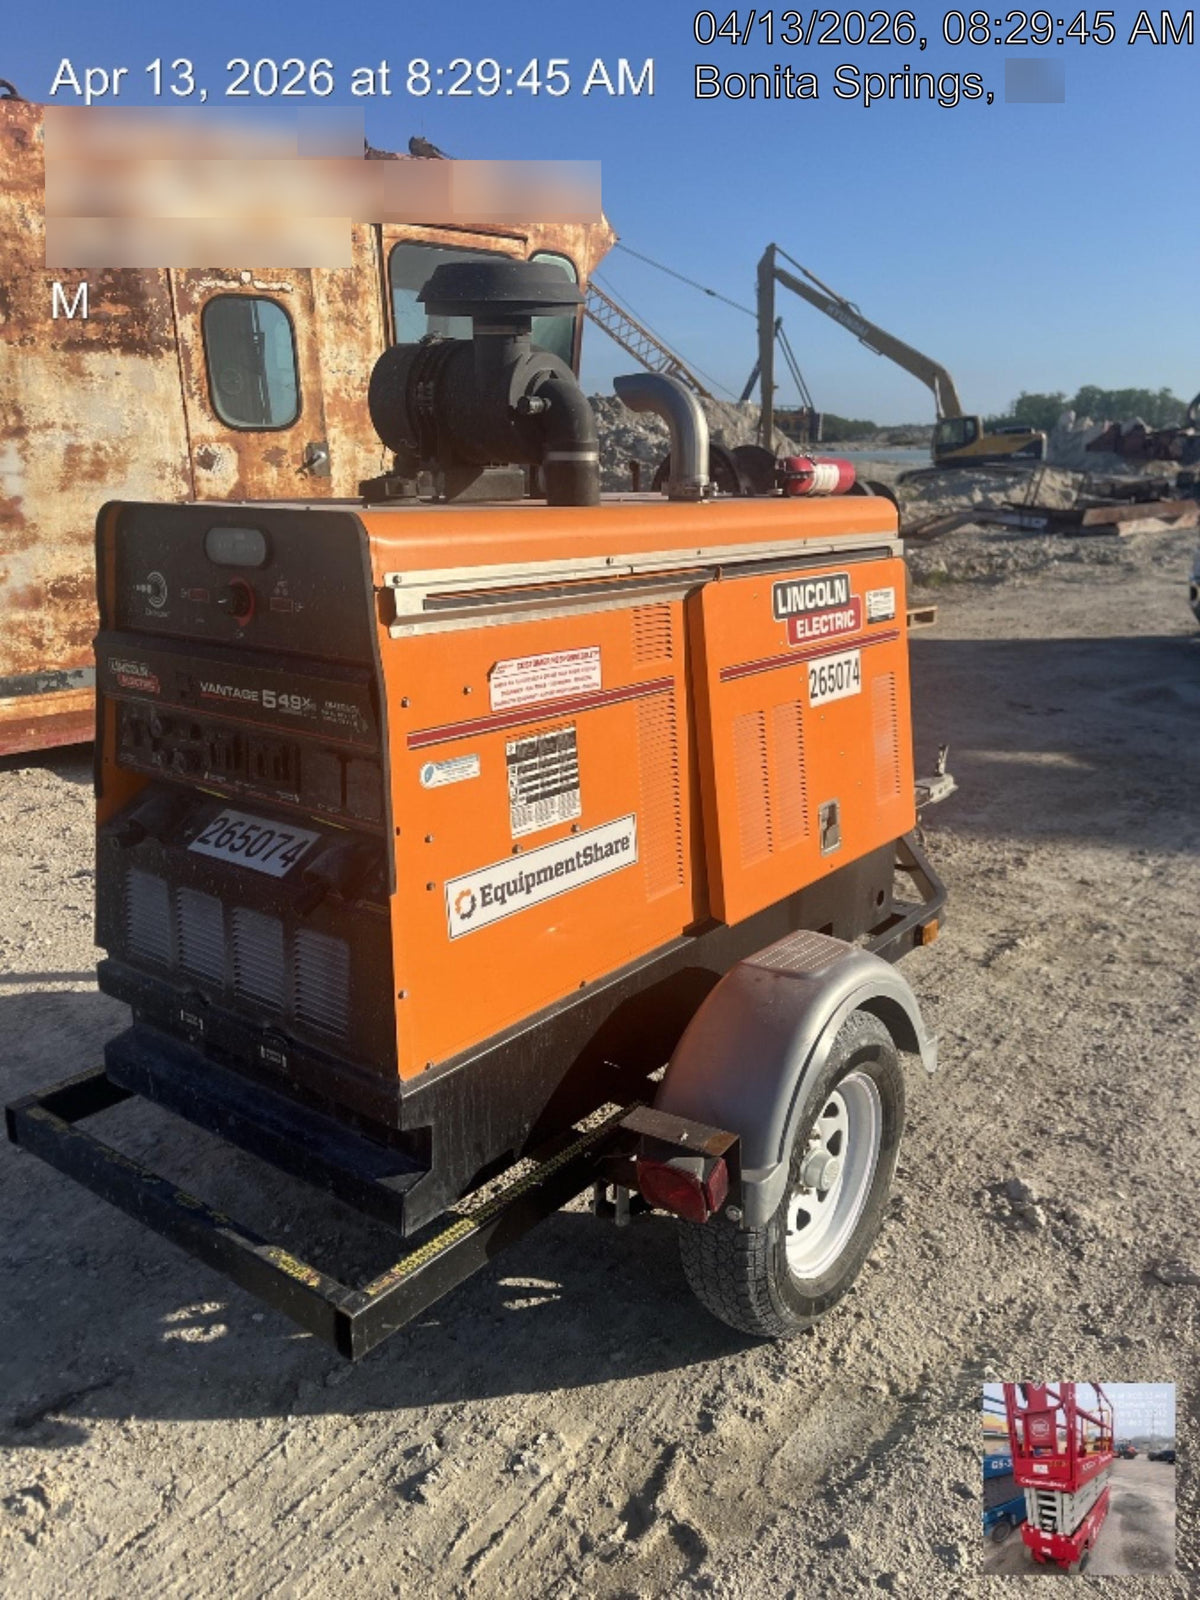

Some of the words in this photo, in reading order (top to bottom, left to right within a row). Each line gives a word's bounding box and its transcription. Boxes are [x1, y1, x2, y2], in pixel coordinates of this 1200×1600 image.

[776, 578, 847, 615] LINCOLN
[795, 609, 857, 640] ELECTRIC
[199, 681, 259, 702] VANTAGE
[809, 658, 860, 699] 265074
[197, 817, 310, 868] 265074
[479, 836, 631, 907] EquipmentShare
